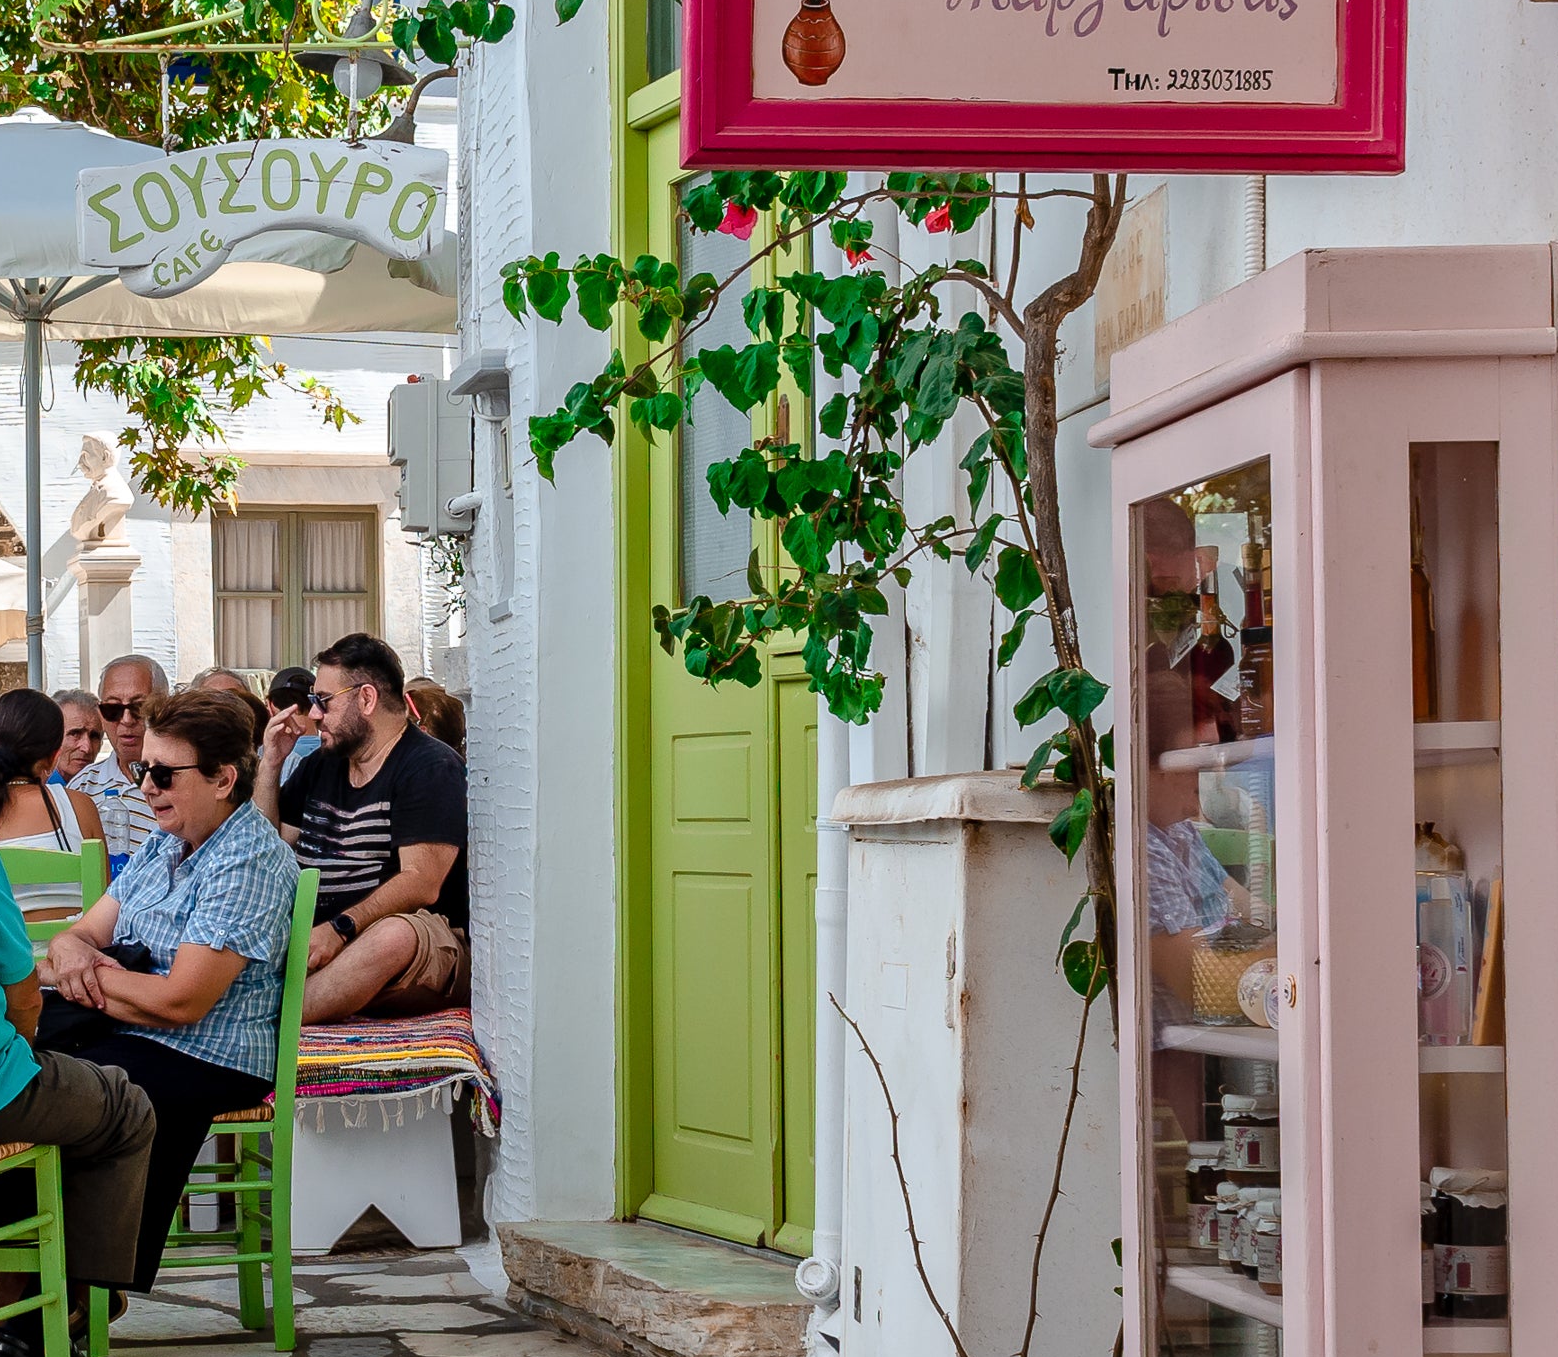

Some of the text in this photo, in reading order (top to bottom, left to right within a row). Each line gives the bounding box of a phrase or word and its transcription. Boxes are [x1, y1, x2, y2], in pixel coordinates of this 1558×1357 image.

[1166, 68, 1274, 92] 2283031885
[87, 149, 437, 253] ΣΟΥΣΟΥΡΟ
[153, 228, 223, 288] CAFE
